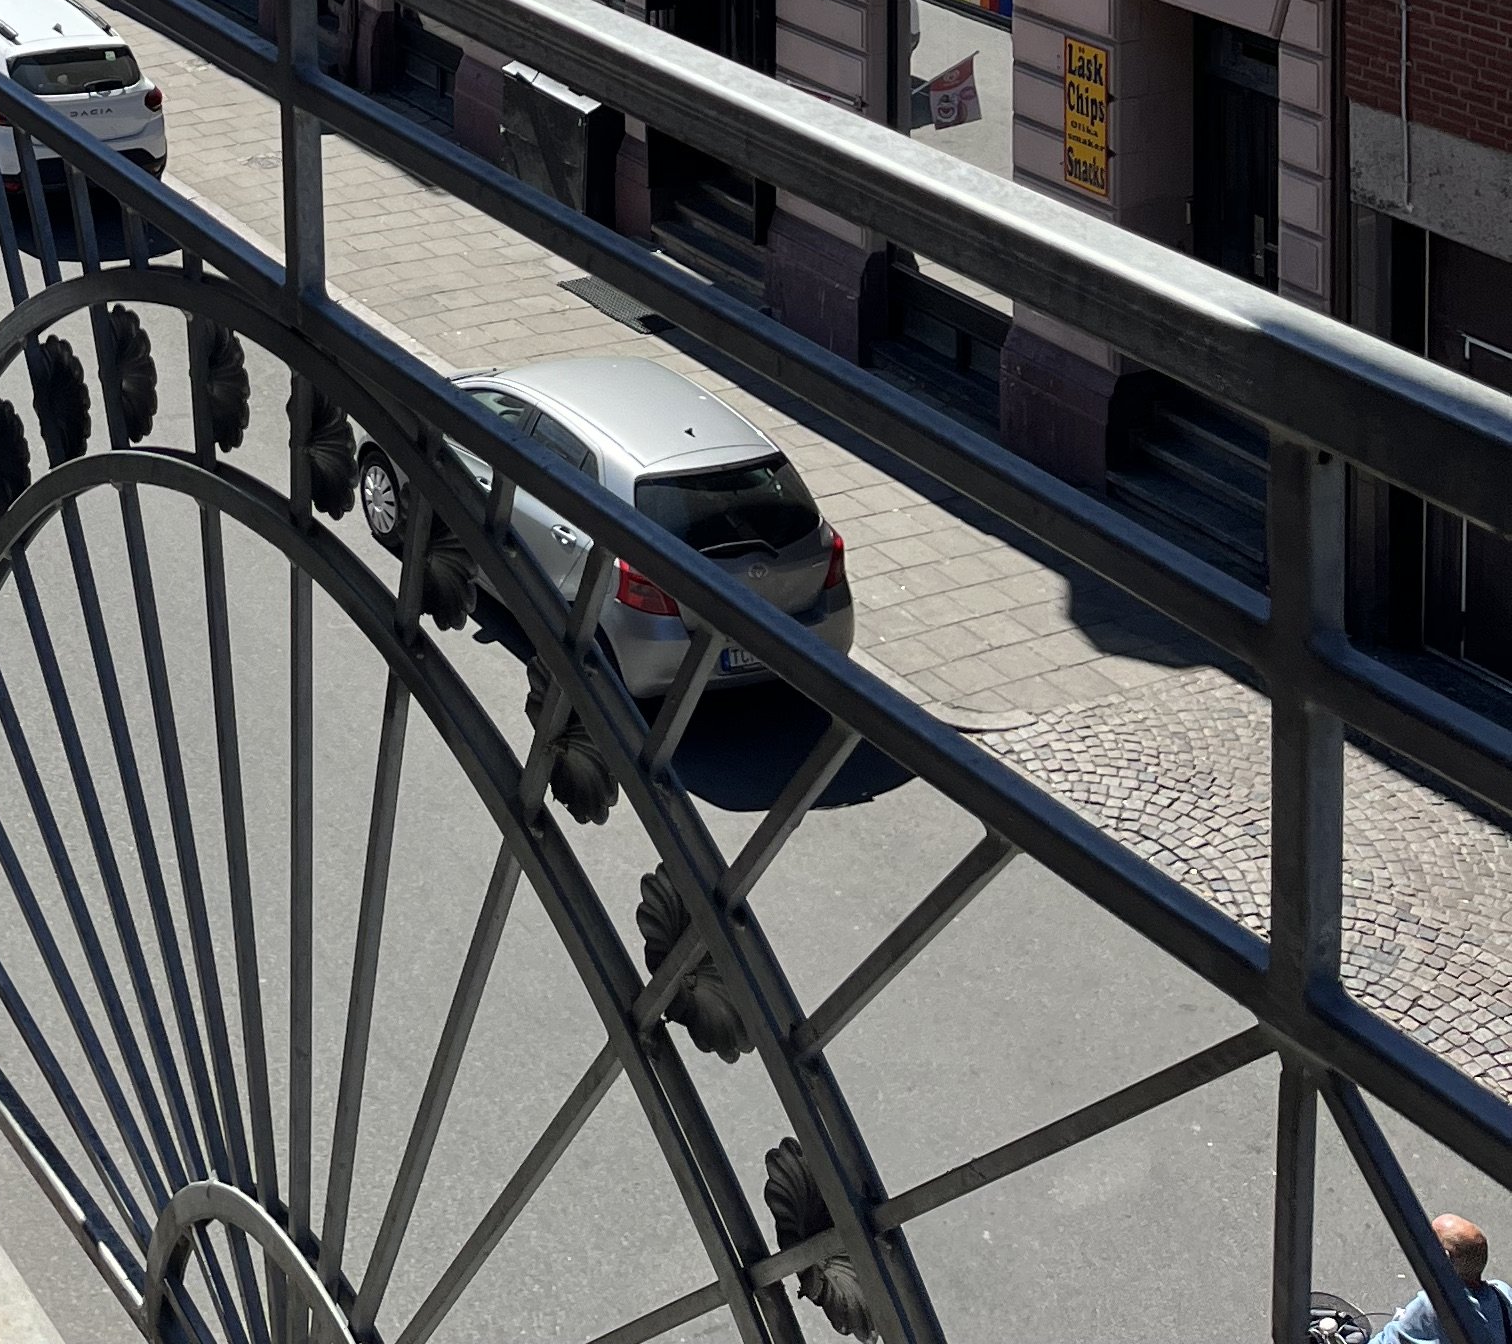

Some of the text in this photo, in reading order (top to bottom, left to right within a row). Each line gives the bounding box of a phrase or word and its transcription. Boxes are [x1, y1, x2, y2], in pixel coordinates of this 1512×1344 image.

[1067, 43, 1104, 86] Läsk
[70, 108, 113, 118] DACIA
[1067, 80, 1105, 127] Chips
[1067, 133, 1105, 152] smaker
[1067, 146, 1105, 190] Snacks
